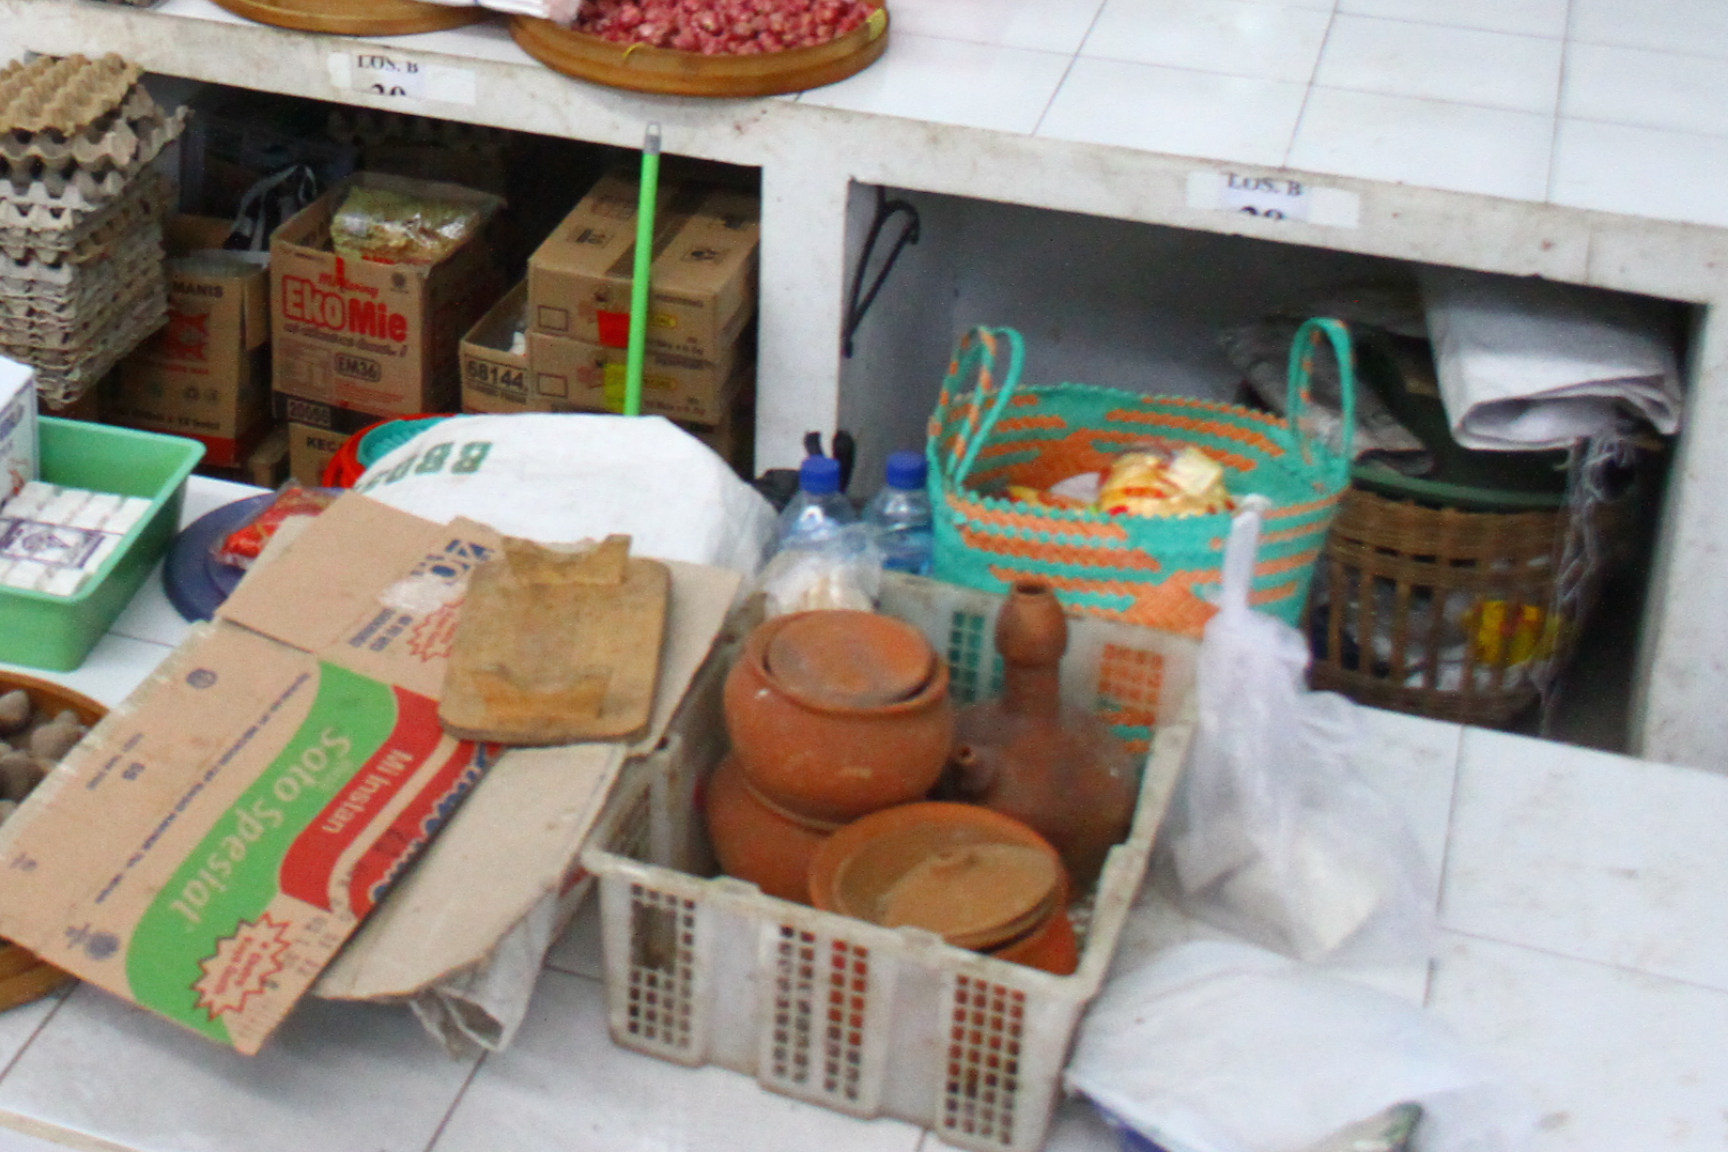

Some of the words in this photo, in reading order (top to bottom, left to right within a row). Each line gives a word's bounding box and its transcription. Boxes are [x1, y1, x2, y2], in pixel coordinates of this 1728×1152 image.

[273, 726, 352, 804] Soto
[375, 747, 415, 778] Mi
[322, 767, 392, 835] Instan
[170, 798, 285, 926] Spesial
